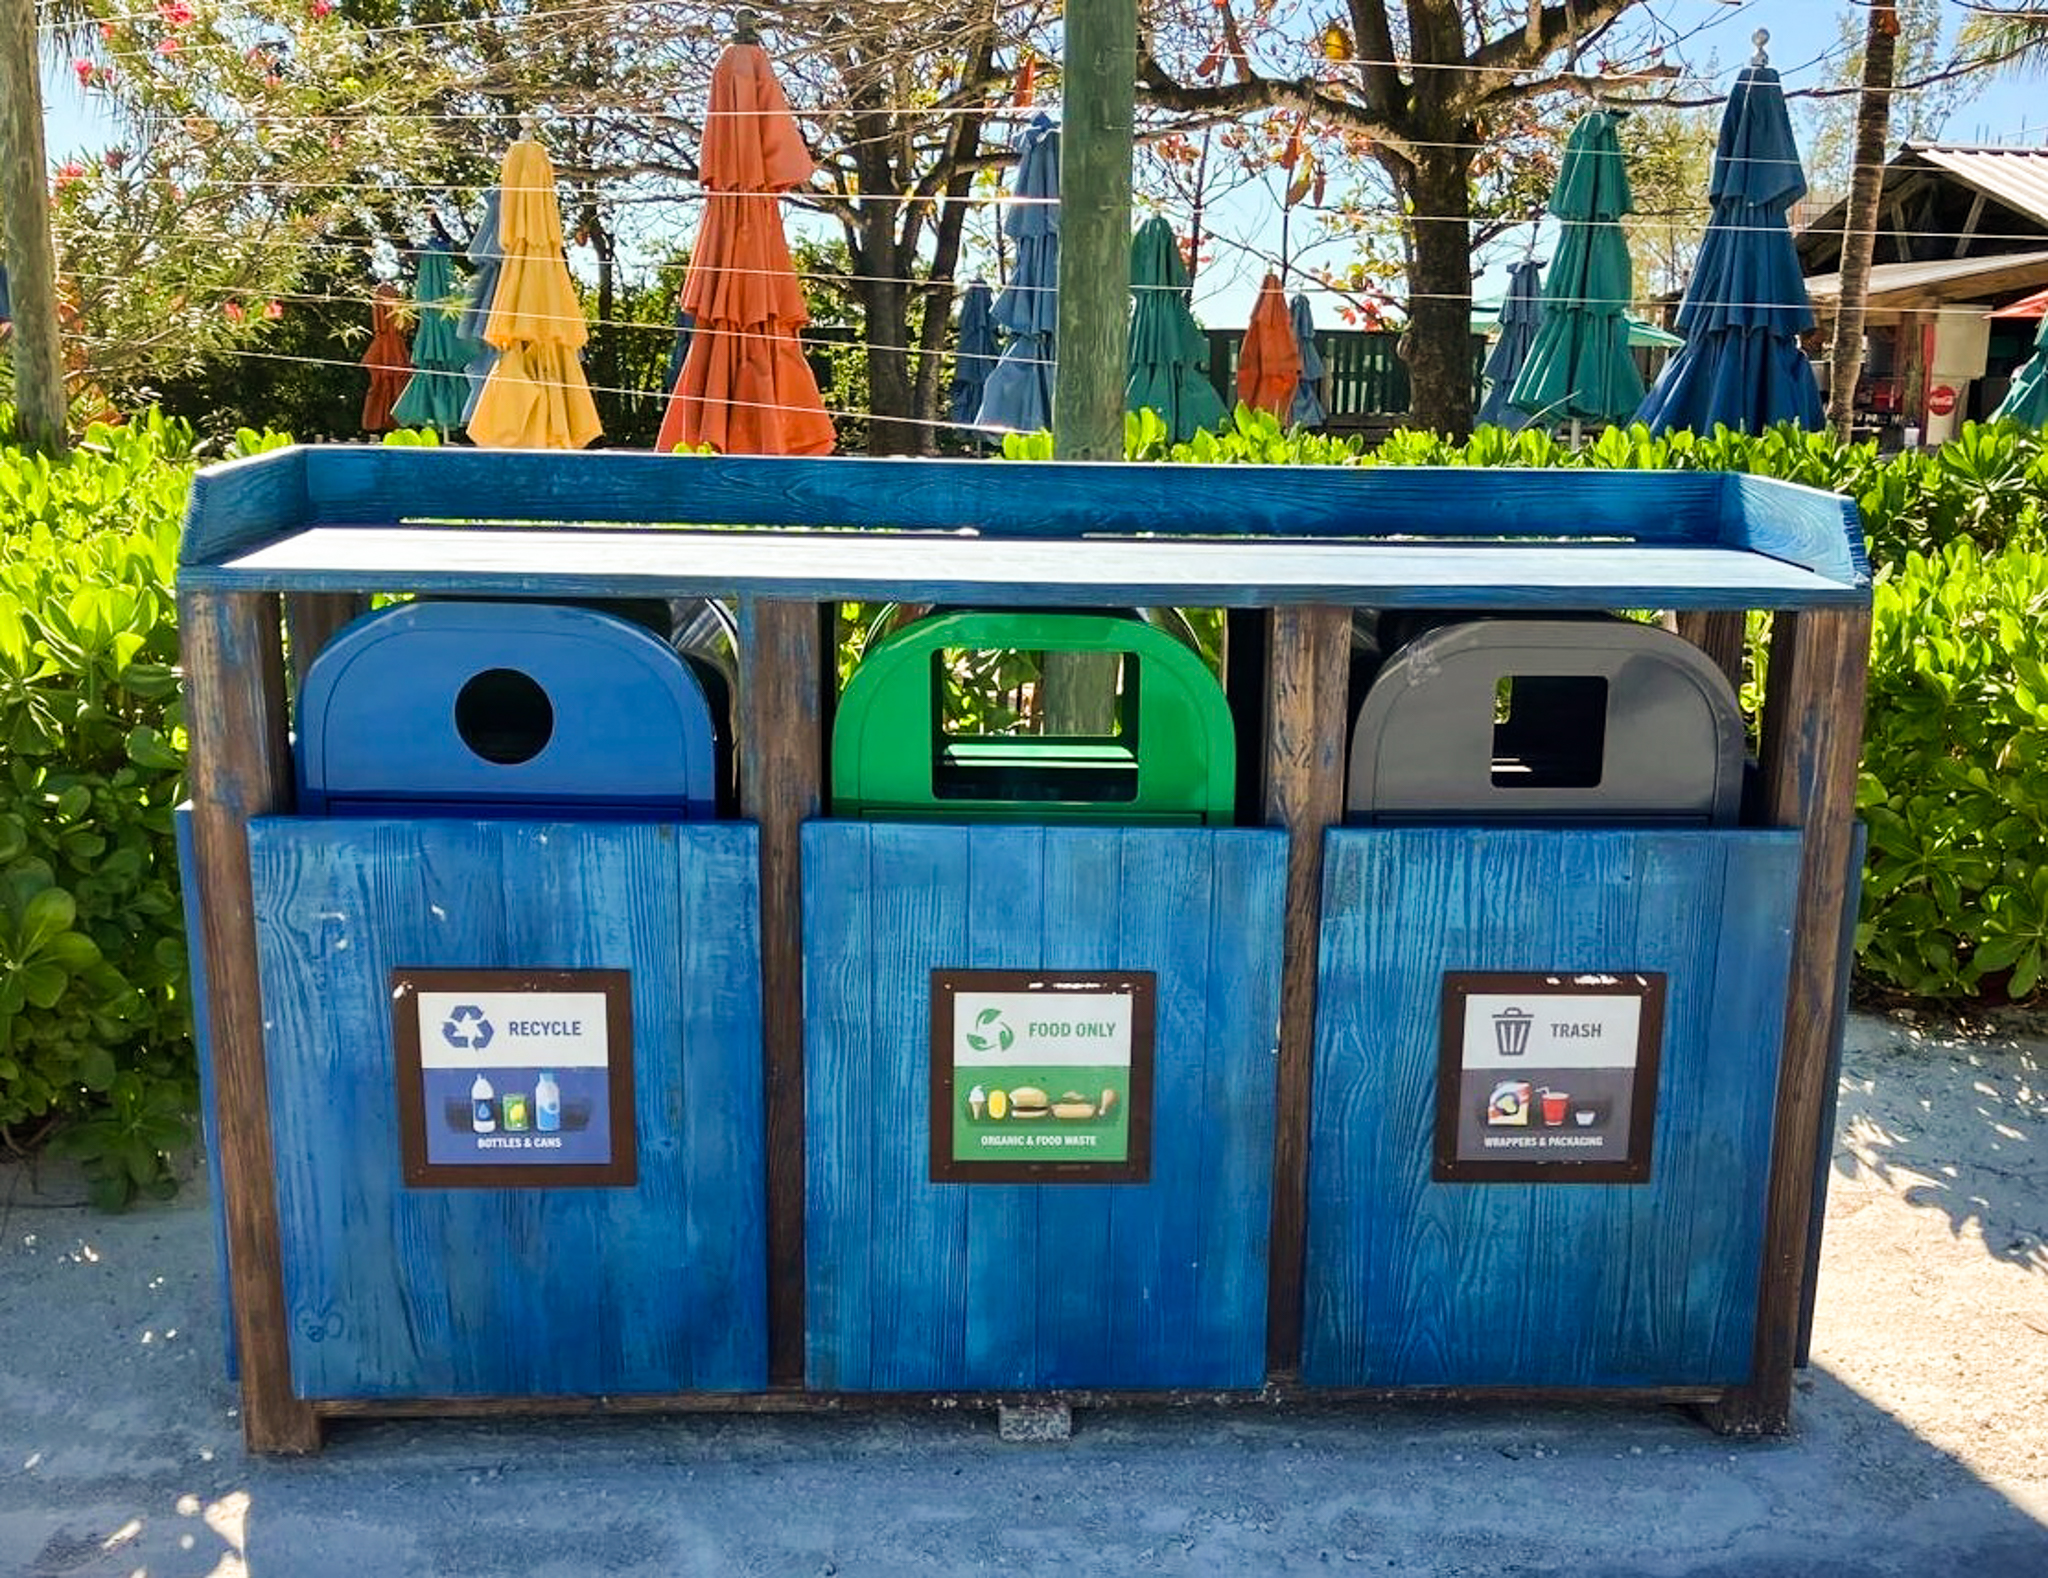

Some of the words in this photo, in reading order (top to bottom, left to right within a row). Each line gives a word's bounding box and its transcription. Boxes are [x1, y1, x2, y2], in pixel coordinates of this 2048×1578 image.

[508, 1020, 582, 1037] RECYCLE
[1028, 1022, 1071, 1038] FOOD
[1076, 1022, 1117, 1038] ONLY
[1550, 1022, 1602, 1038] TRASH
[477, 1137, 522, 1149] BOTTLES
[523, 1137, 532, 1149] &
[534, 1137, 562, 1149] CANS
[981, 1135, 1025, 1147] ORGANIC
[1026, 1135, 1034, 1147] &
[1036, 1135, 1063, 1147] FOOD
[1064, 1135, 1098, 1147] WASTE
[1484, 1136, 1537, 1148] WRAPPERS
[1538, 1136, 1546, 1148] &
[1548, 1135, 1604, 1147] PACKAGING
